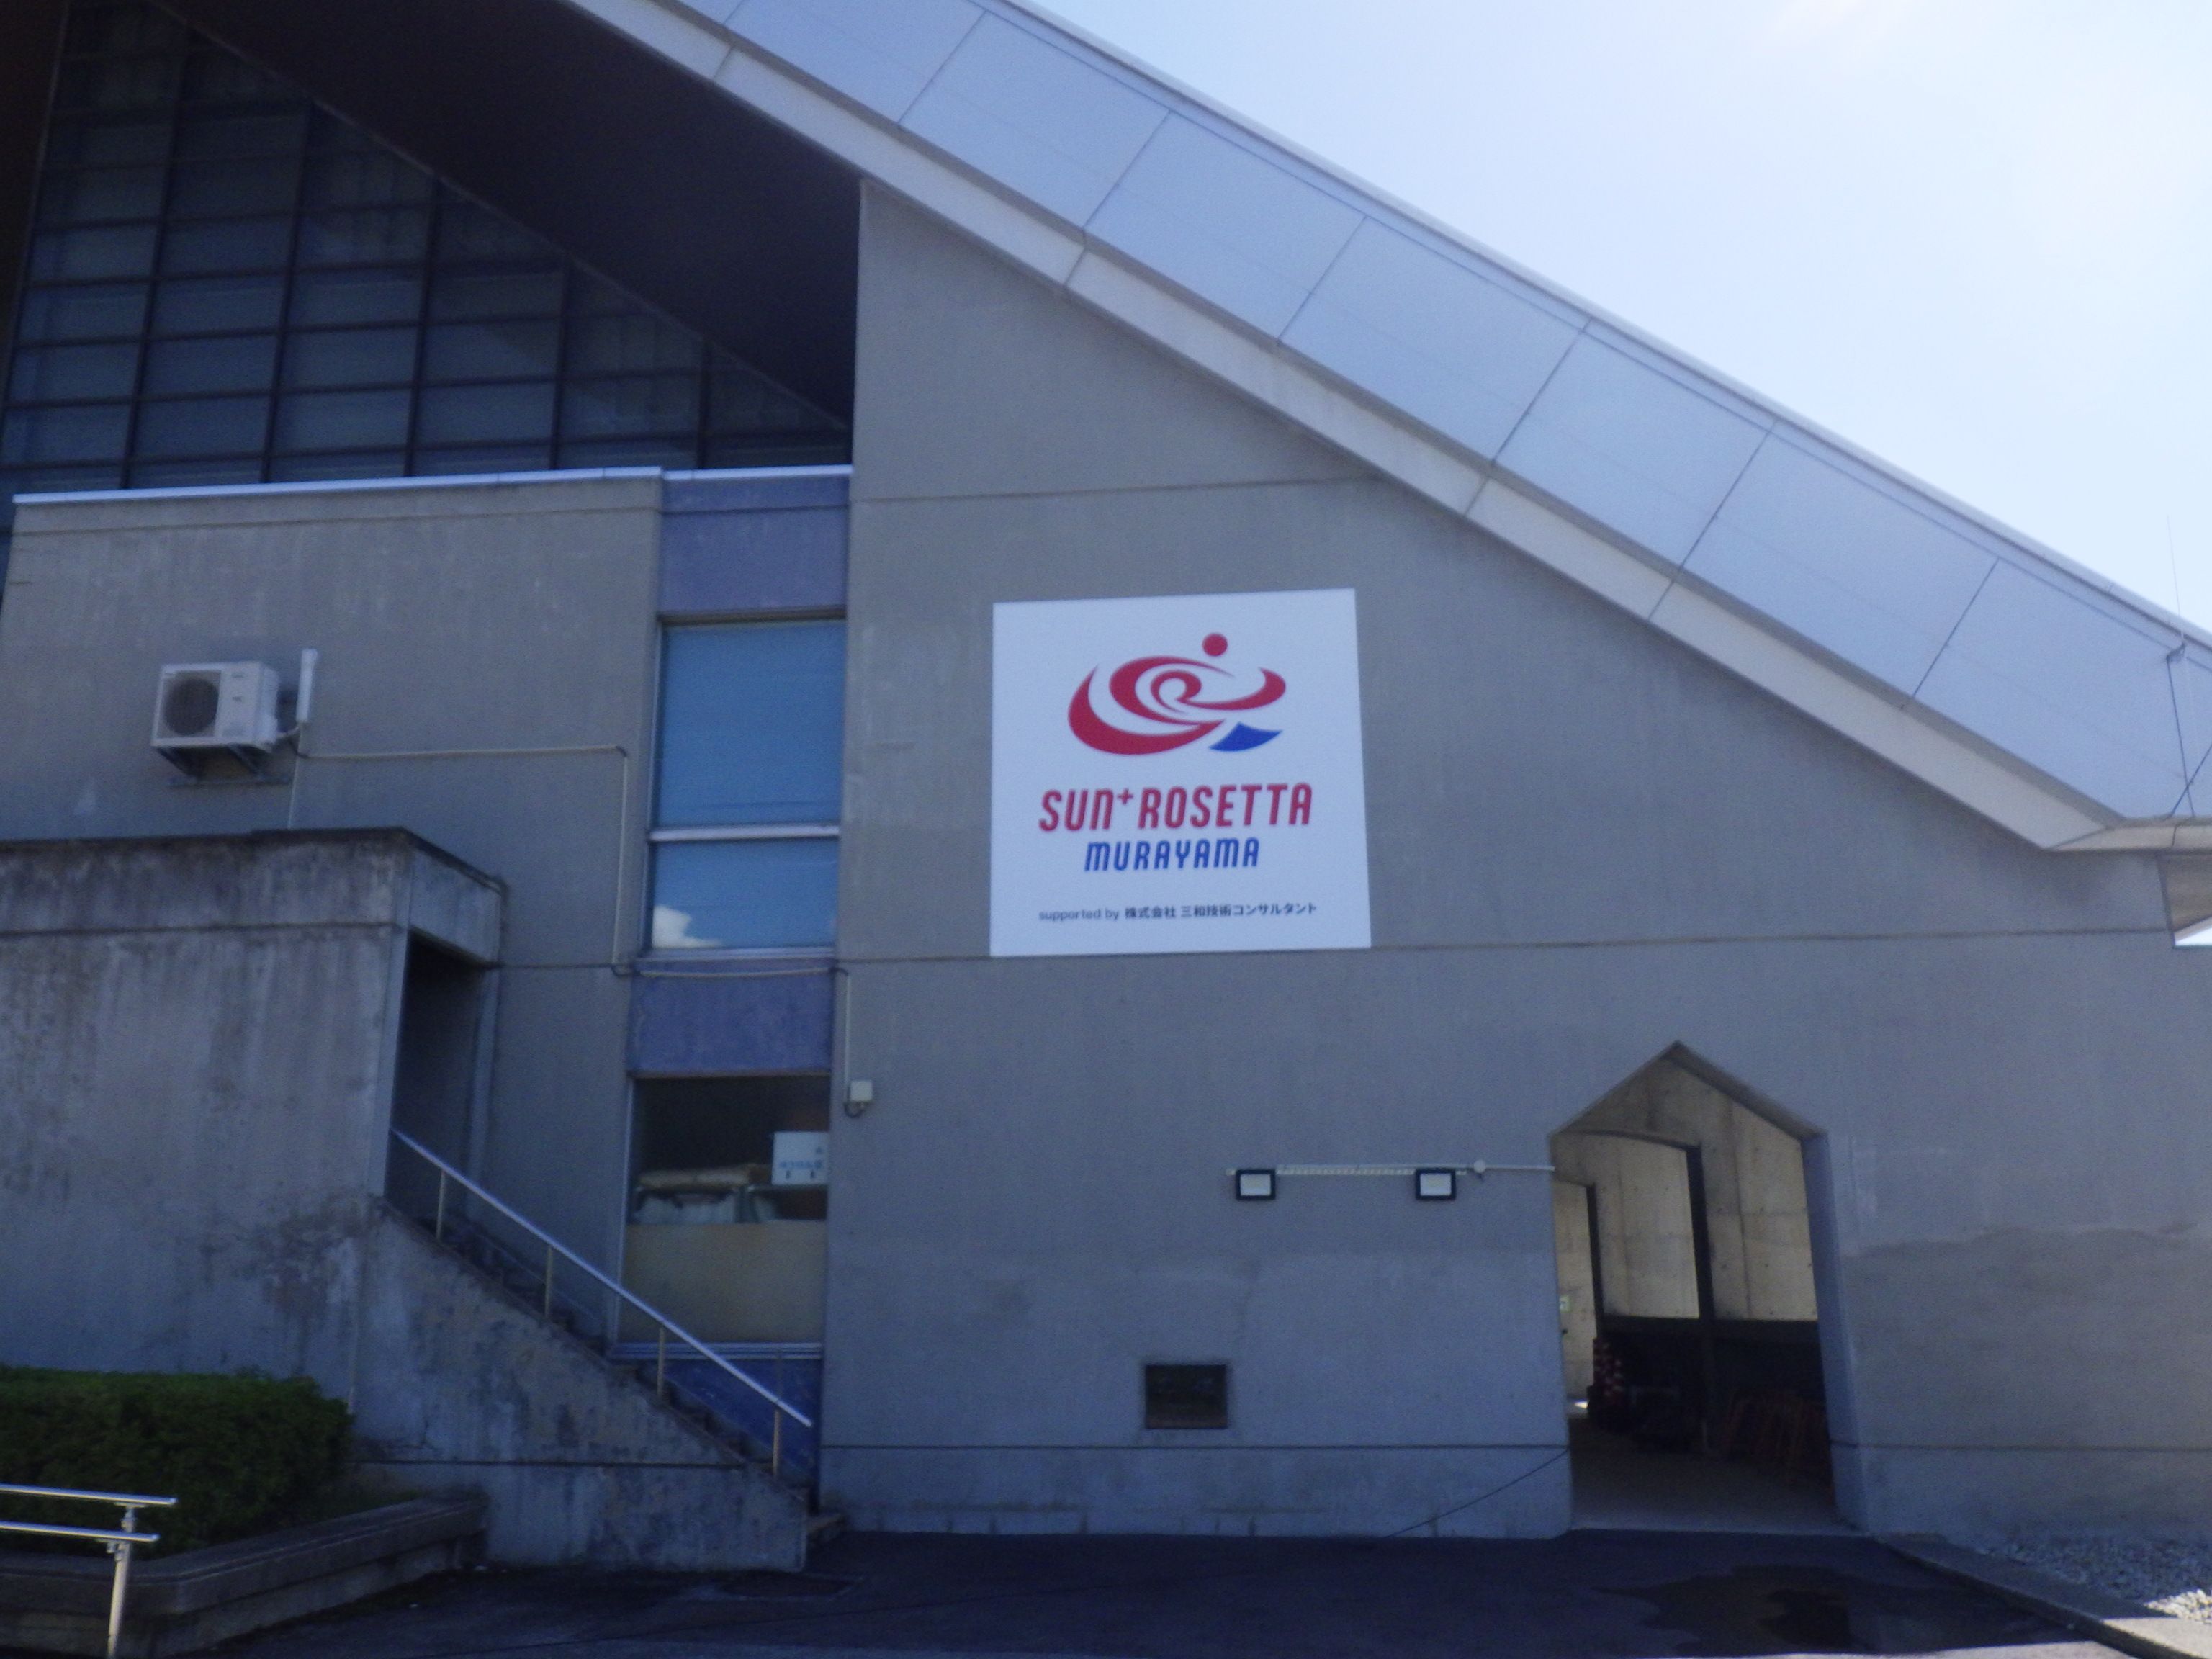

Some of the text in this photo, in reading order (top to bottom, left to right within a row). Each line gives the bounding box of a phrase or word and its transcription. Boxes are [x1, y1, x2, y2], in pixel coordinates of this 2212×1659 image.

[1084, 837, 1259, 871] MURAYAMA
[1038, 902, 1317, 922] supported by 株式会社 三和技術コンサルタント
